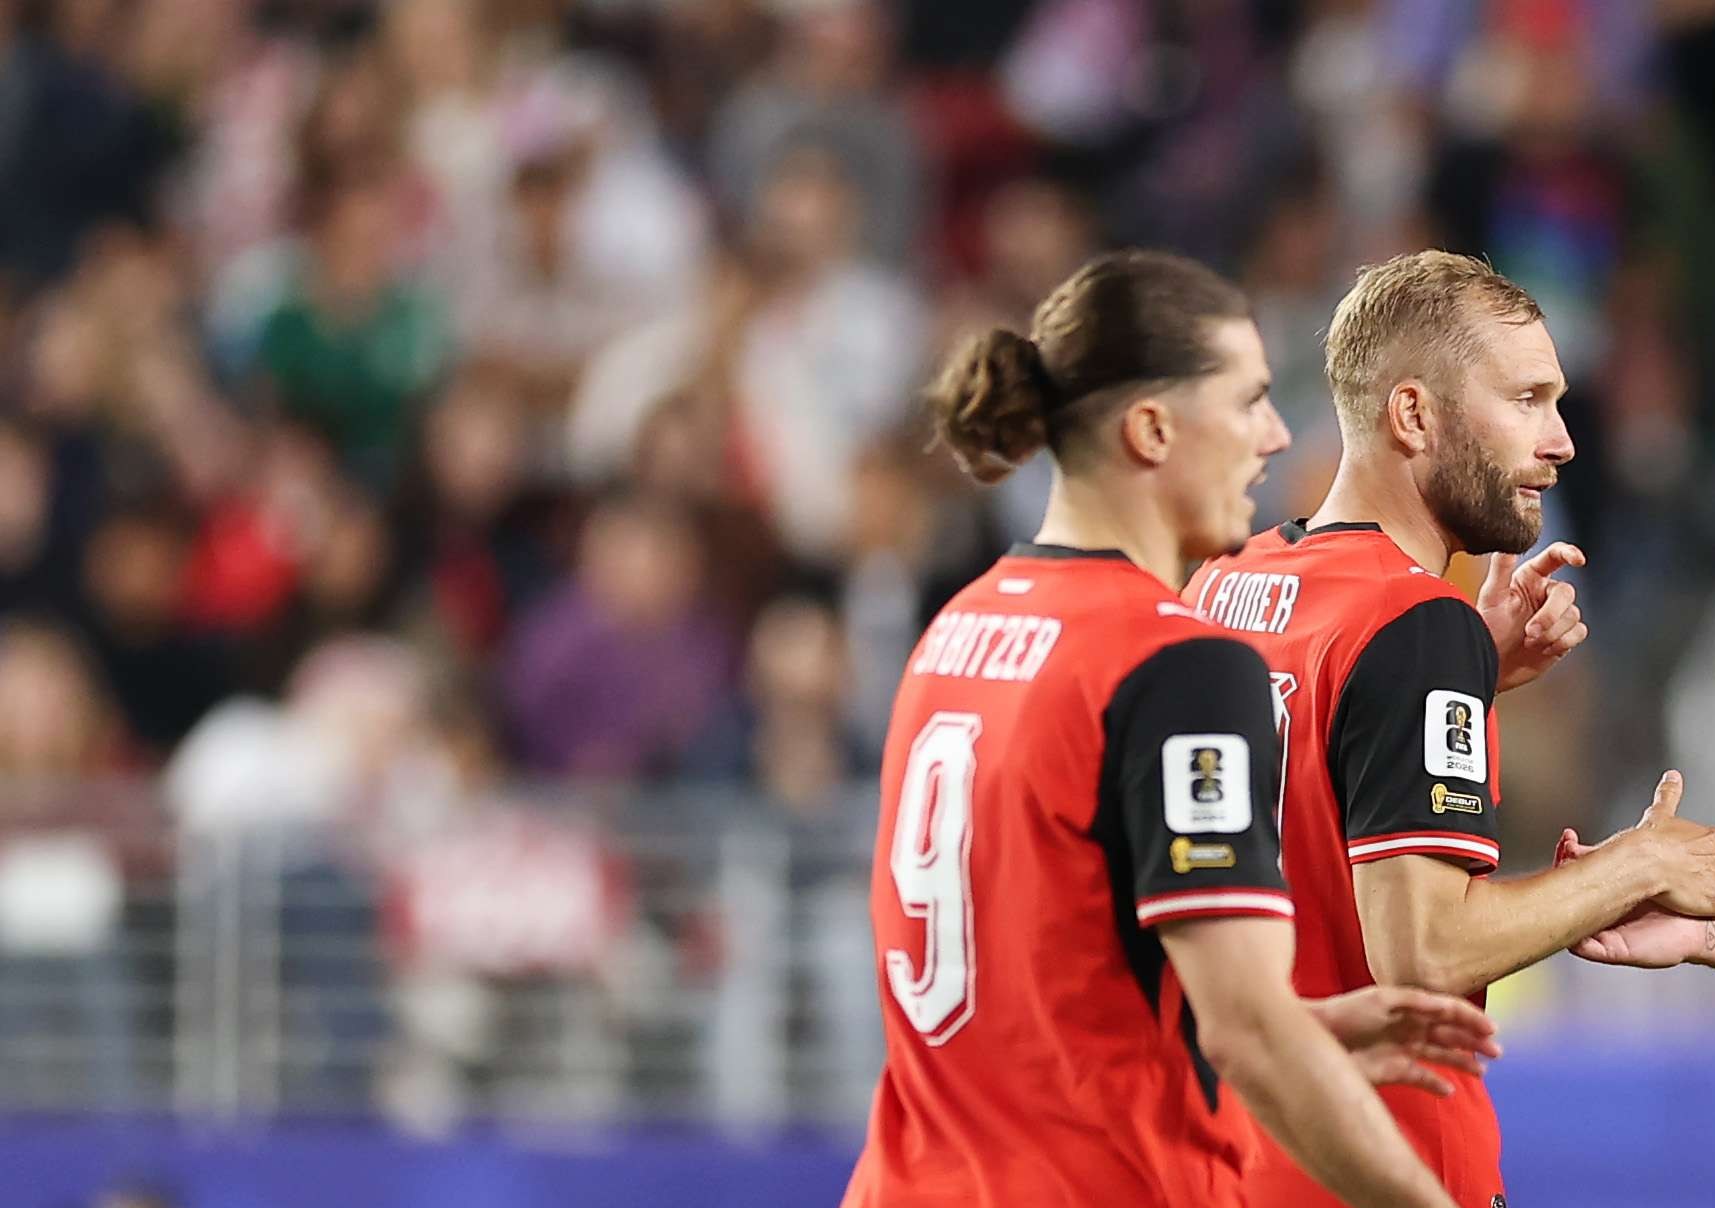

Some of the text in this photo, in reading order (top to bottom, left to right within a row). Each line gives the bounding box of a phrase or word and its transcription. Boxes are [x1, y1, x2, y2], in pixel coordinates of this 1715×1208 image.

[1194, 568, 1300, 634] LAIMER
[1445, 796, 1478, 808] DEBUT
[886, 711, 982, 1047] 9
